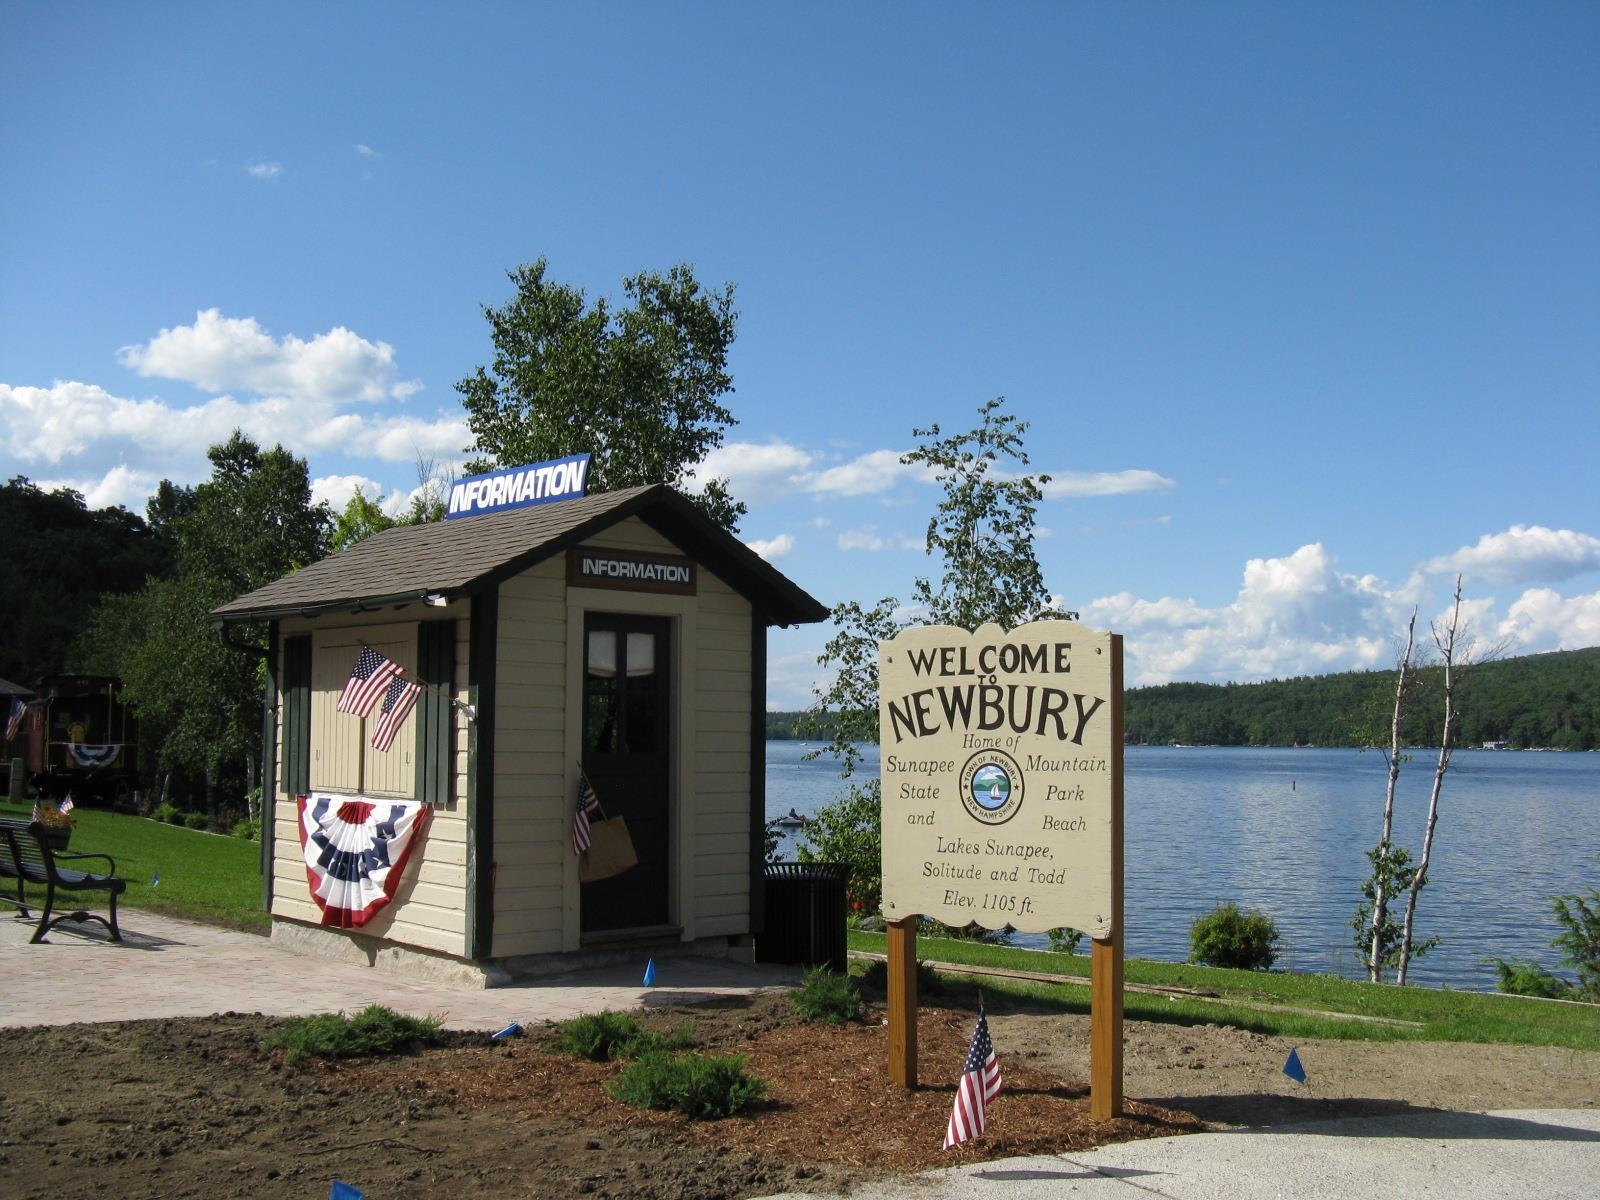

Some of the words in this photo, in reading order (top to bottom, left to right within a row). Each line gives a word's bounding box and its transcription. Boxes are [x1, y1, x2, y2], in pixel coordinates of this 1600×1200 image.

[450, 460, 586, 513] INFORMATION
[582, 558, 690, 583] INFORMATION
[907, 643, 1072, 677] WELCOME
[977, 674, 997, 685] TO
[888, 684, 1106, 746] NEWBURY
[962, 733, 1001, 749] Home
[1006, 736, 1021, 753] of
[886, 756, 955, 777] Sunapee
[1025, 755, 1107, 772] Mountain
[964, 761, 978, 782] TOWN
[990, 755, 1017, 780] NEWBURY
[900, 782, 940, 799] State
[1045, 785, 1085, 801] Park
[966, 796, 979, 812] NEW
[978, 799, 1016, 819] HAMPSHIRE
[907, 811, 935, 825] and
[1042, 815, 1087, 832] Beach
[936, 837, 980, 854] Lakes
[985, 839, 1054, 861] Sunapee,
[922, 862, 982, 880] Solitude
[990, 867, 1018, 882] and
[1028, 867, 1067, 885] Todd
[942, 890, 977, 908] Elev.
[982, 893, 1016, 911] 1105
[1017, 898, 1035, 916] ft.
